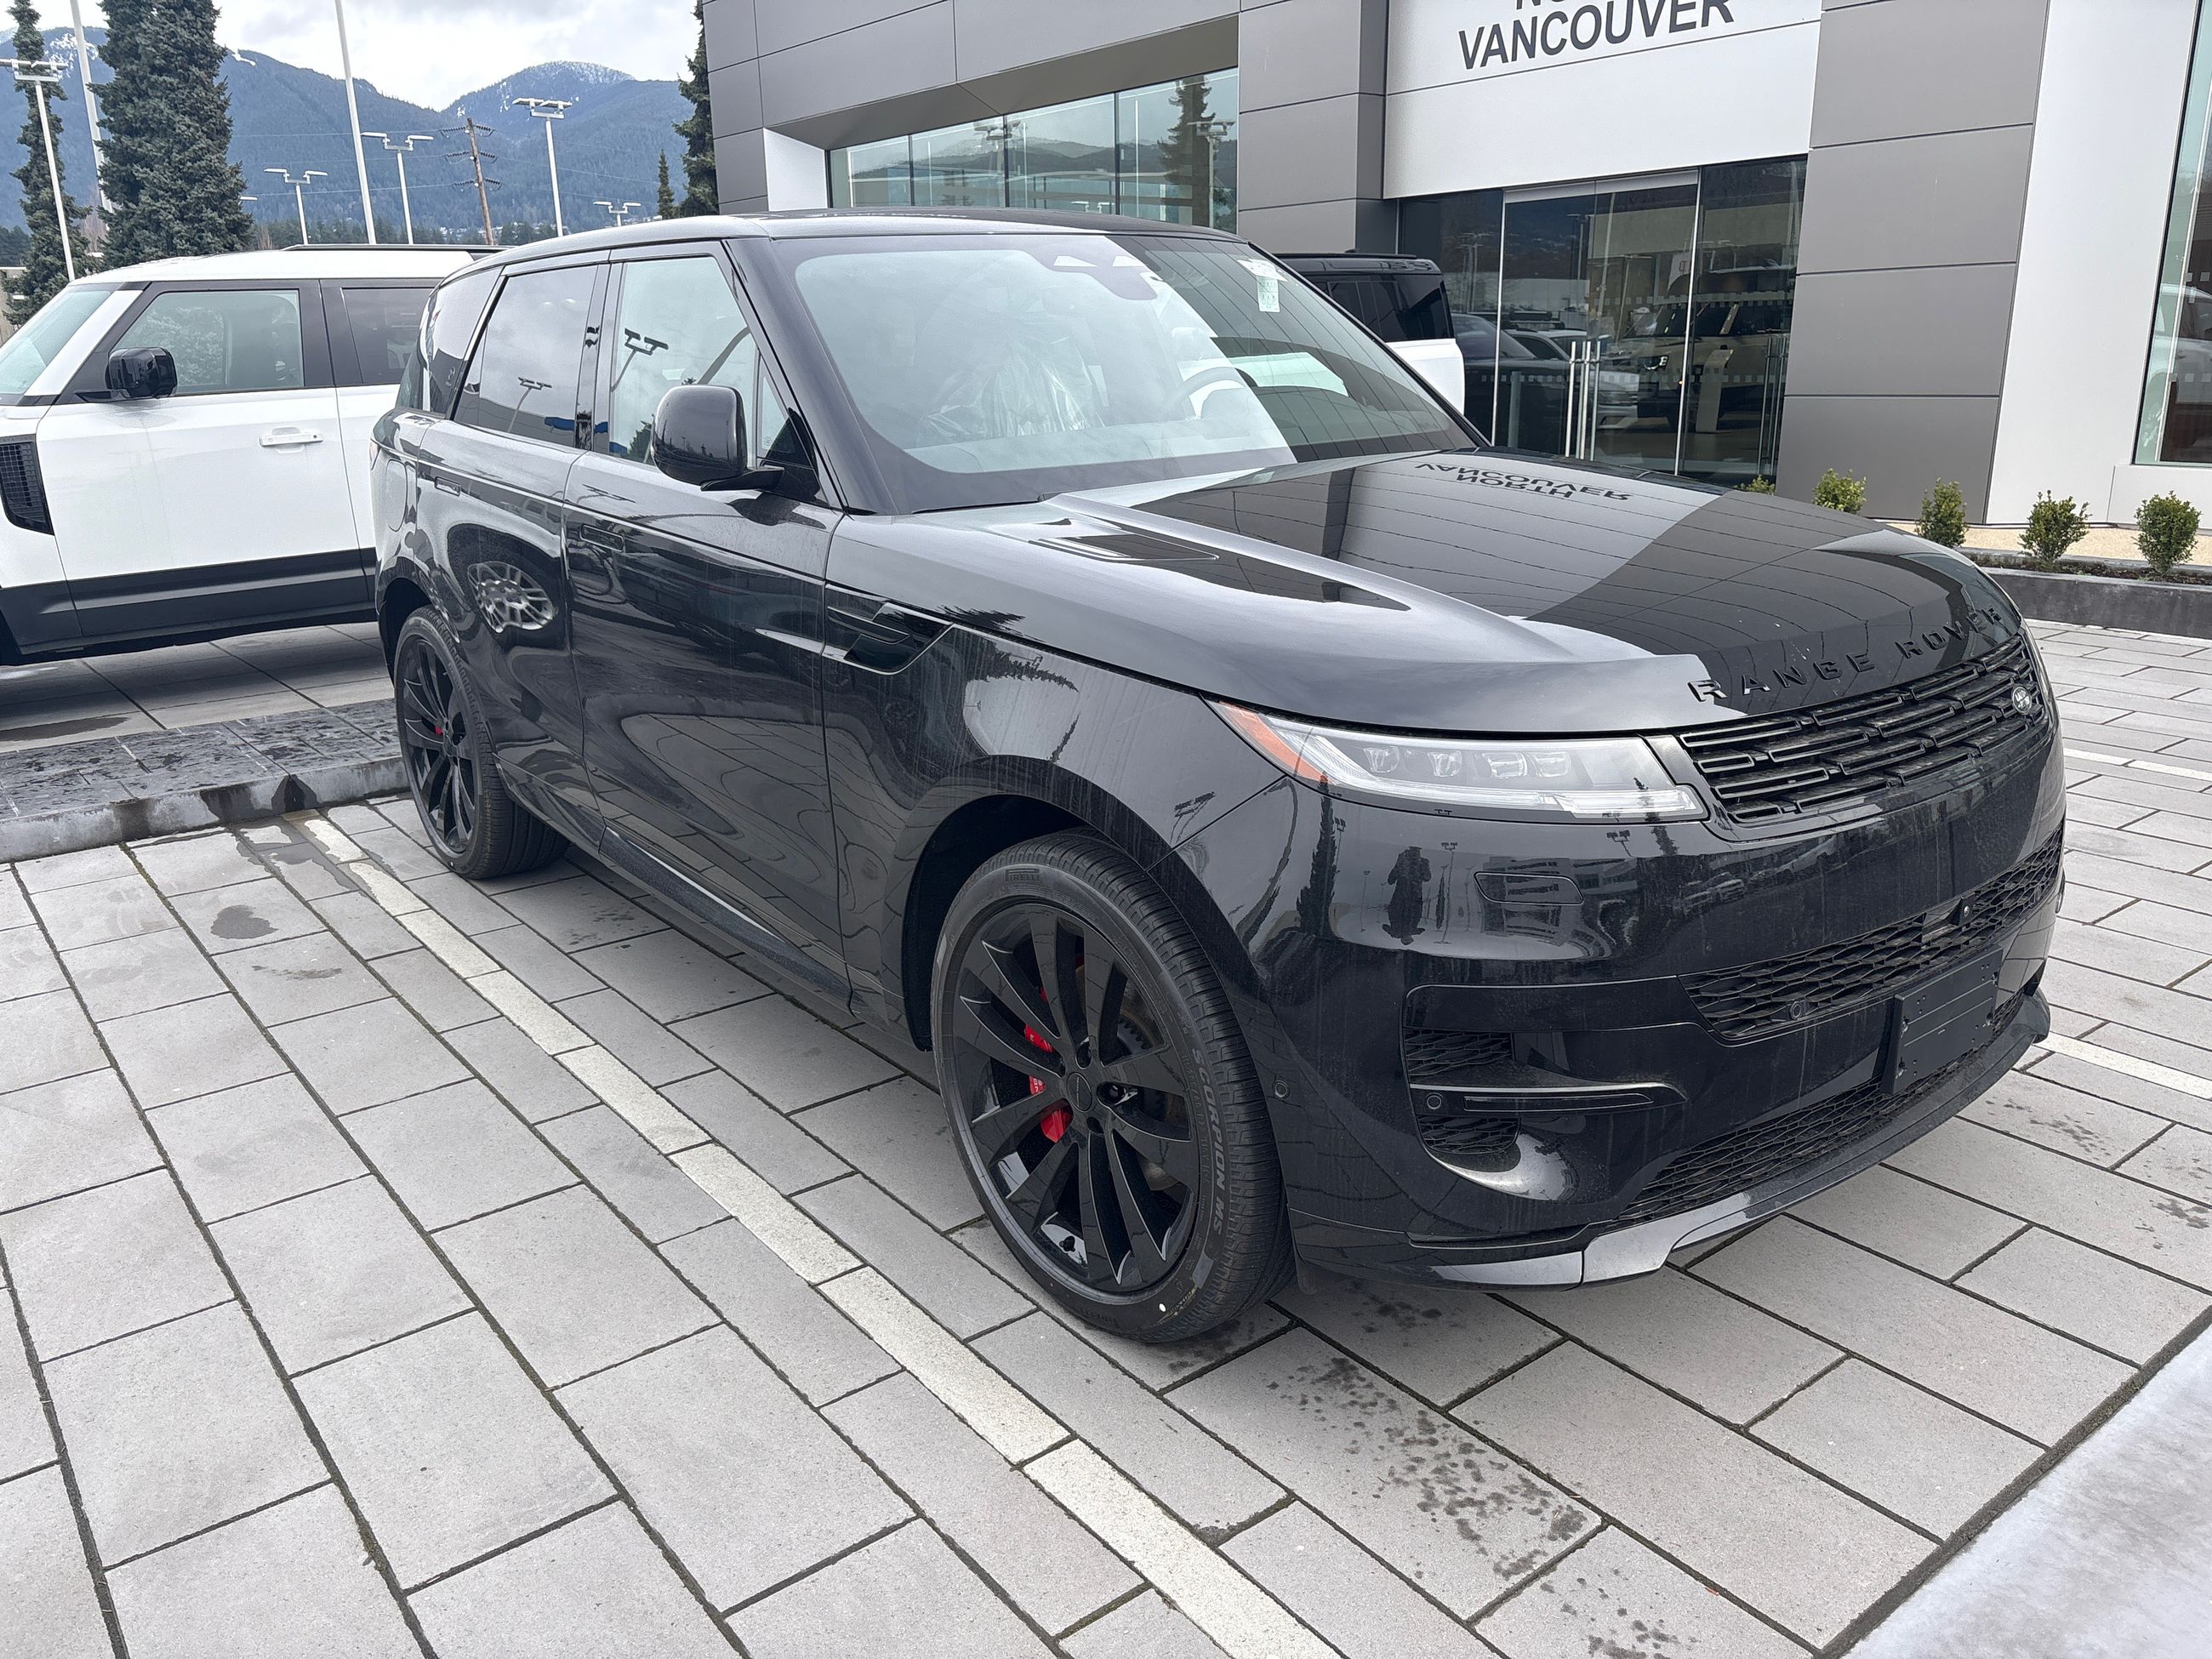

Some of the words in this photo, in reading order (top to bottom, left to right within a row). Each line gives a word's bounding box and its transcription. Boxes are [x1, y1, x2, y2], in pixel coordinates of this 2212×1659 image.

[1458, 0, 1735, 70] VANCOUVER
[1687, 653, 1875, 703] RANGE
[1894, 607, 2002, 660] ROVER
[1005, 868, 1040, 882] PIRELLI
[1192, 1047, 1226, 1191] SCORPION
[1213, 1195, 1225, 1235] MS
